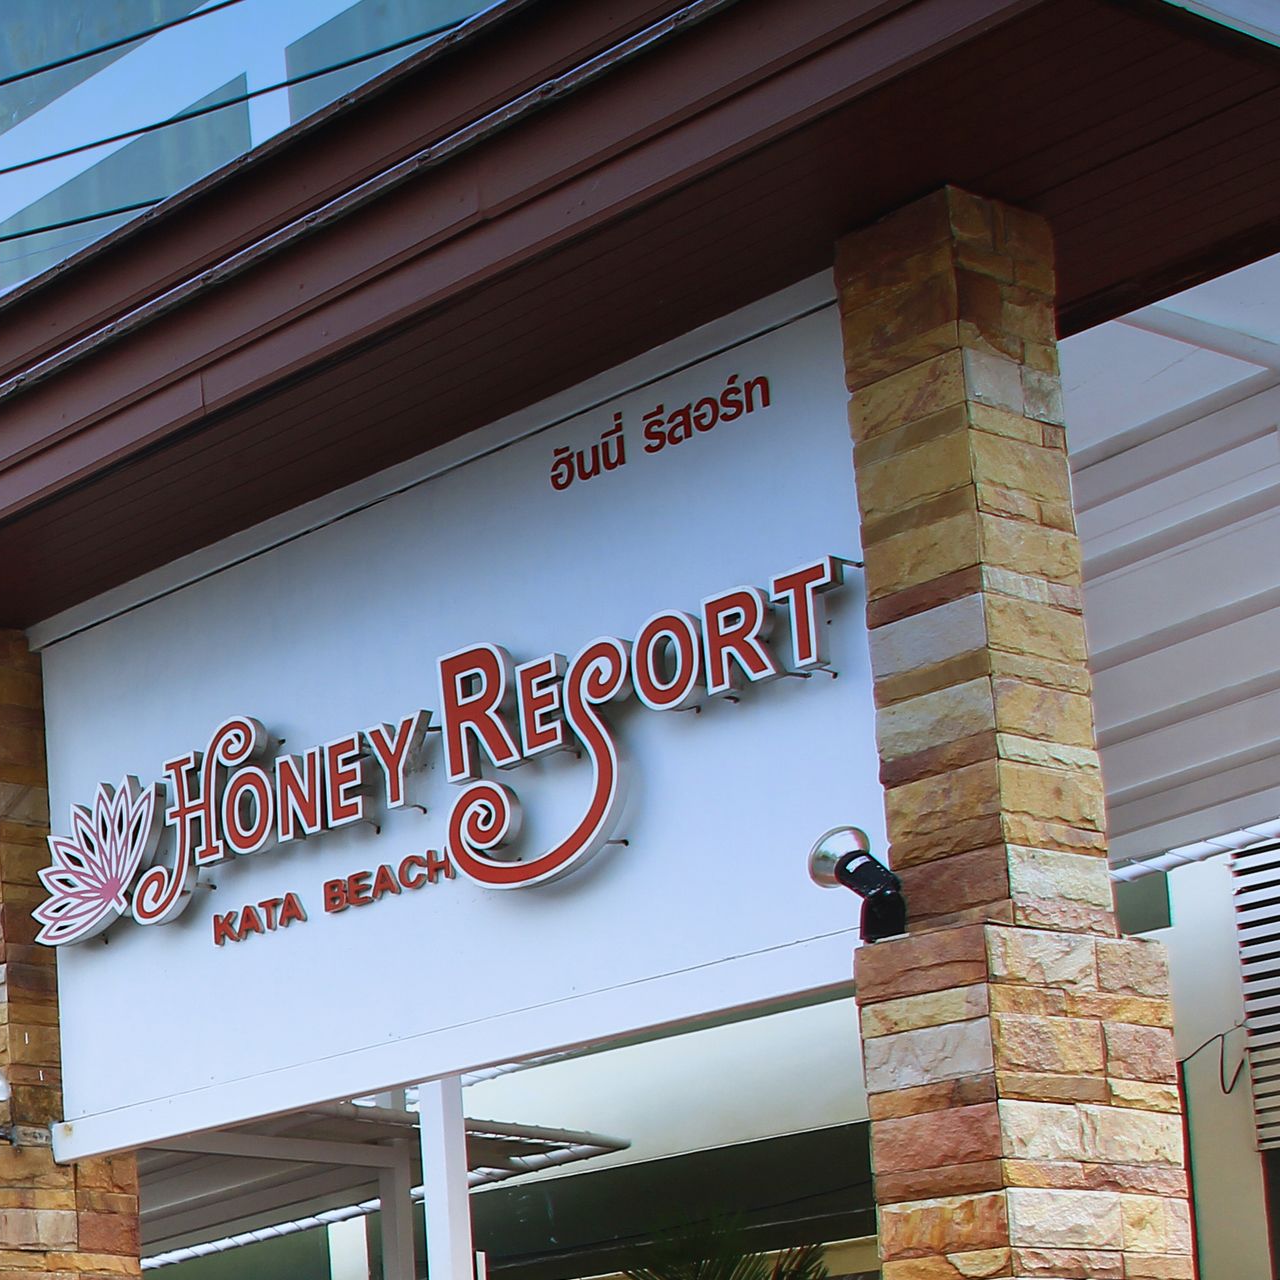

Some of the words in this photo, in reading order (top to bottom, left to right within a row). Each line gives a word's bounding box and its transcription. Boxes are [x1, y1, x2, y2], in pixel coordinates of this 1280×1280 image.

[642, 373, 771, 454] รีสอร์ท
[132, 711, 430, 926] HONEY
[437, 555, 835, 891] RESORT
[212, 891, 307, 947] KATA
[322, 846, 457, 914] BEACH
